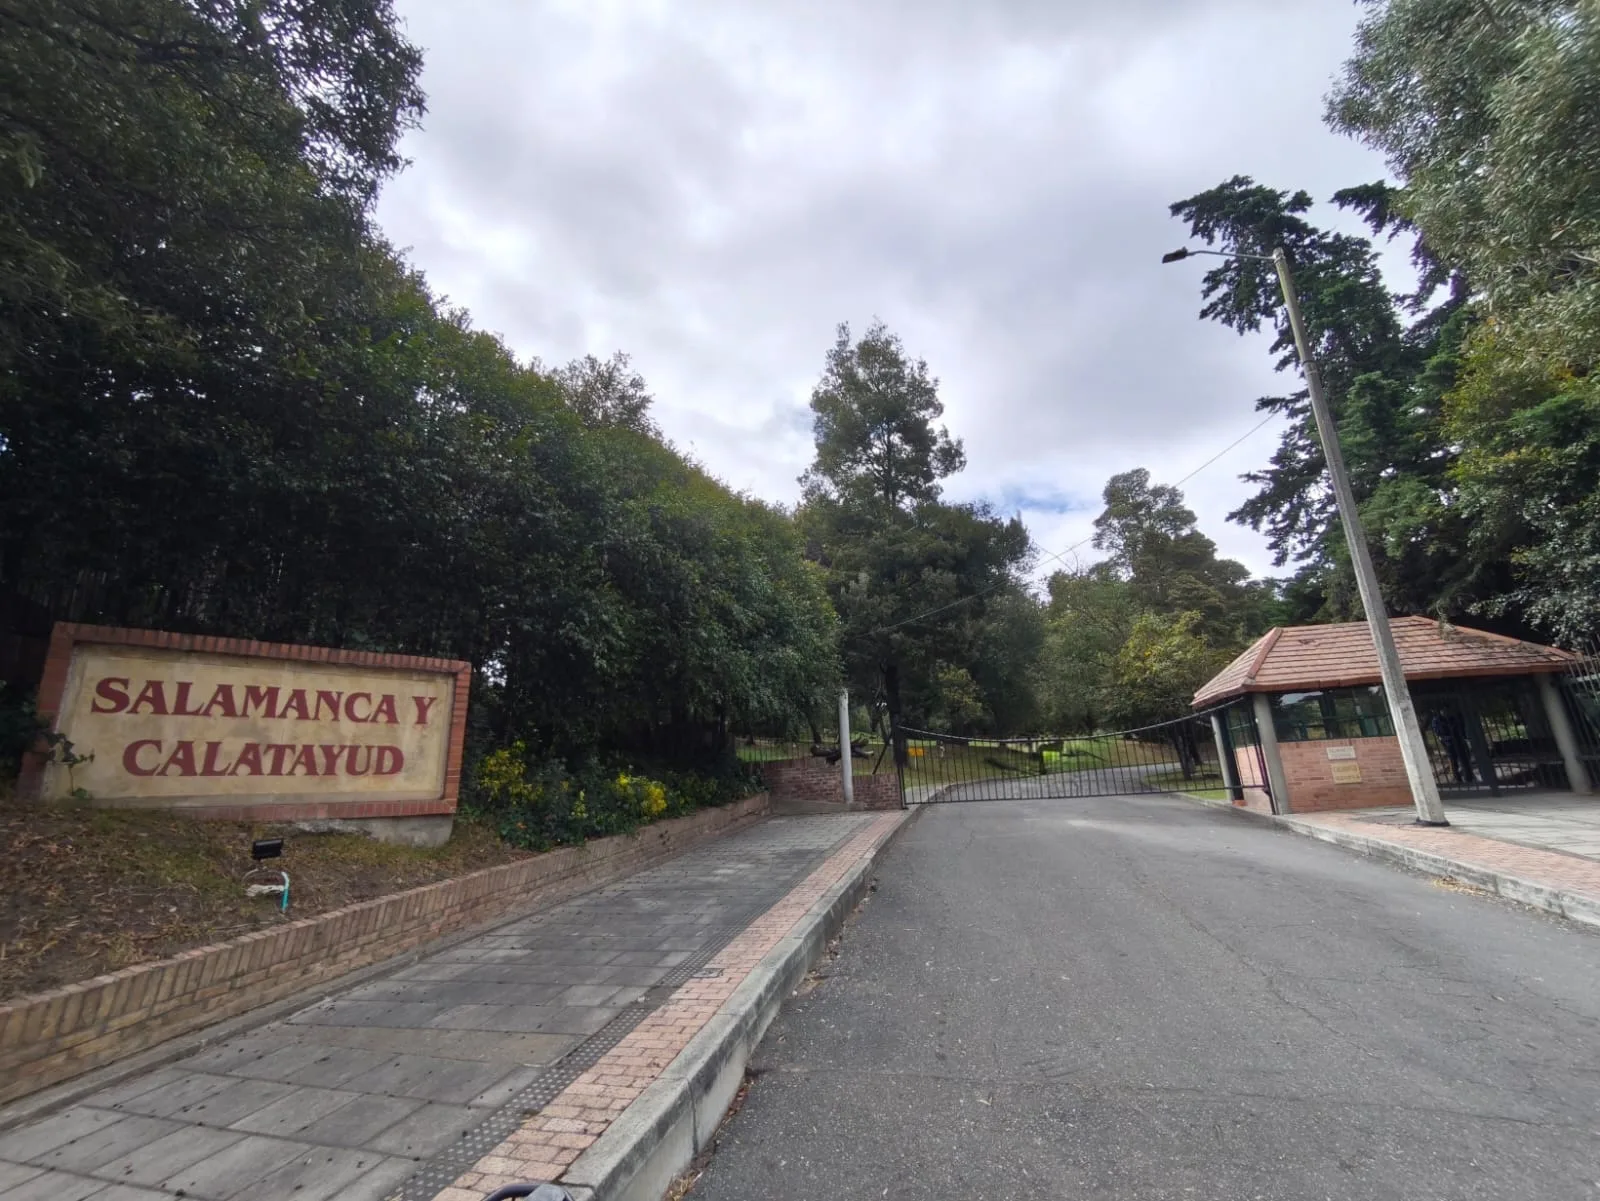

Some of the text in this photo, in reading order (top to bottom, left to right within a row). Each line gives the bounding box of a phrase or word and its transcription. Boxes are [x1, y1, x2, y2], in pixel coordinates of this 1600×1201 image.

[91, 677, 436, 725] SALAMANCA Y
[122, 739, 404, 776] CALATAYUD
